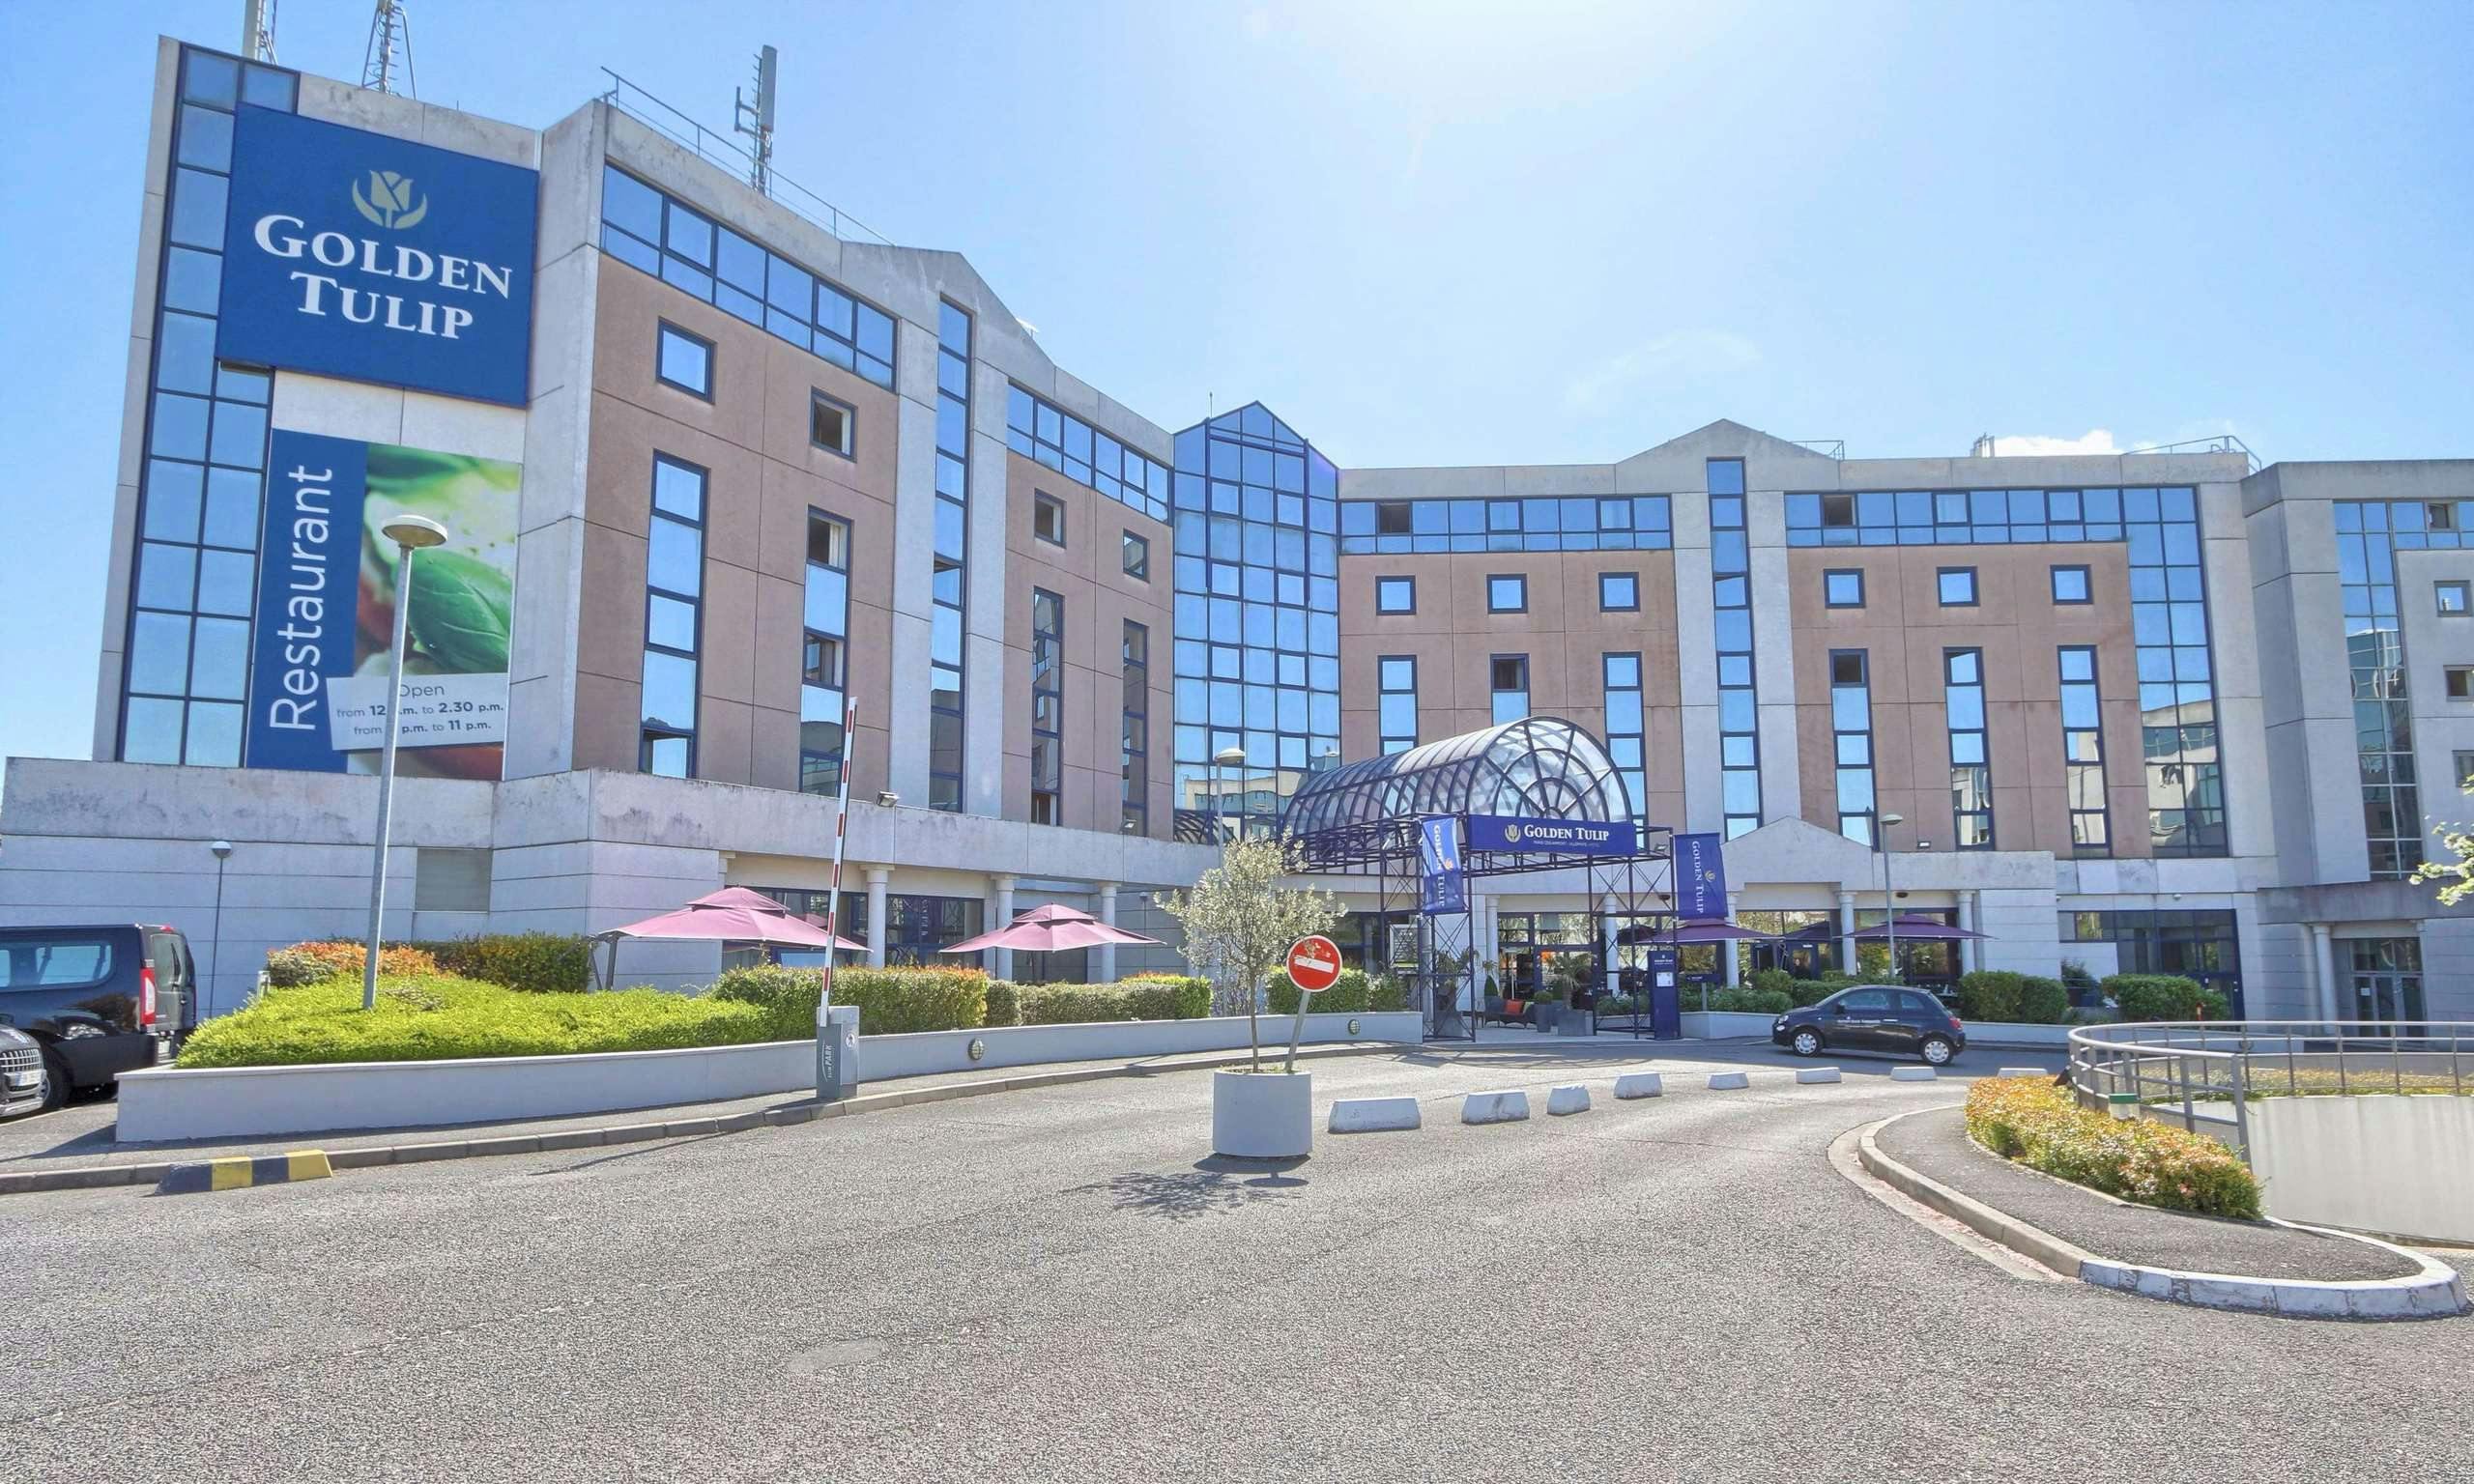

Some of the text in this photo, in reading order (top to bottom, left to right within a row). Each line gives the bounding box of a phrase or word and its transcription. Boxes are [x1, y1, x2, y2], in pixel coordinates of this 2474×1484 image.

[254, 214, 513, 300] GOLDEN
[290, 271, 474, 339] TULIP
[270, 465, 332, 731] Restaurant
[336, 708, 365, 718] from
[422, 705, 434, 714] to
[439, 701, 474, 713] 2.30
[478, 703, 503, 713] p.m.
[354, 720, 492, 735] from p.m. to 11 p.m.
[1524, 824, 1609, 841] GOLDEN TULIP
[1691, 841, 1705, 914] GOLDEN TULIP
